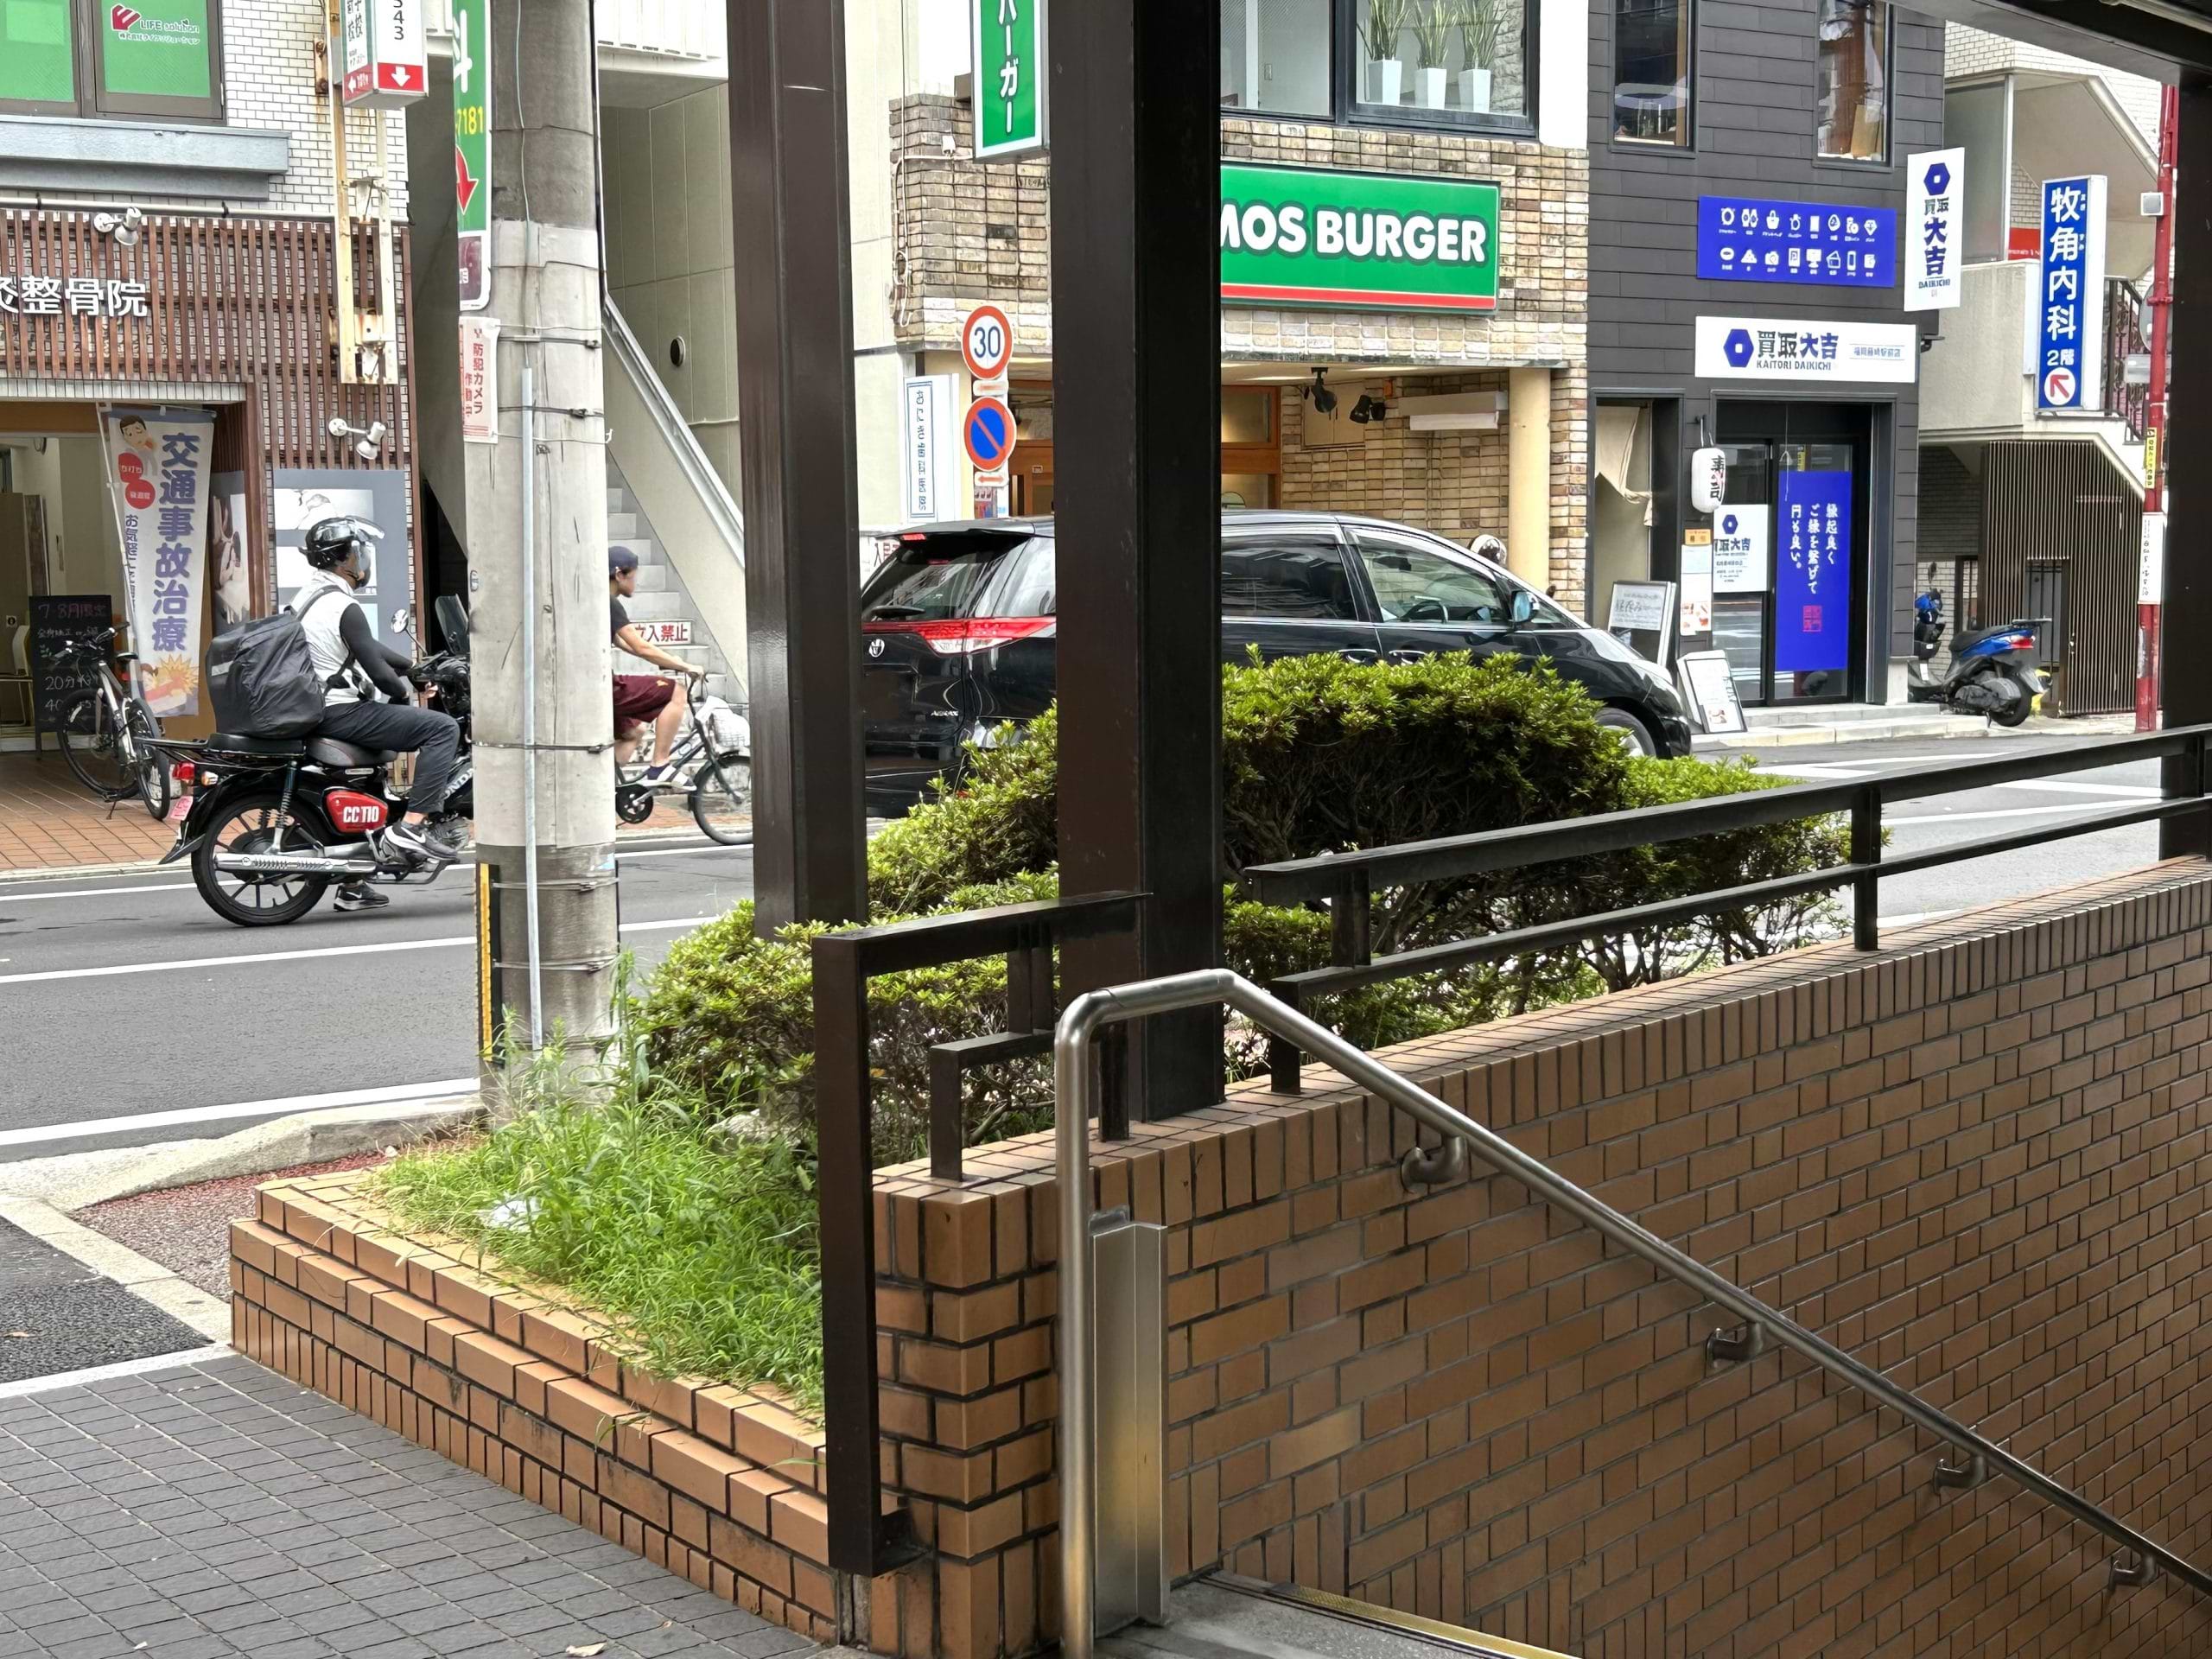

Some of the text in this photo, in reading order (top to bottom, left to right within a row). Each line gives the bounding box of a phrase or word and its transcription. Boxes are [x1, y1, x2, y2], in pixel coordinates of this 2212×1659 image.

[140, 20, 162, 30] LIFE
[1316, 210, 1486, 263] BURGER
[2047, 186, 2081, 341] 牧角内科
[974, 326, 1001, 359] 30
[1757, 330, 1839, 359] 買取大吉
[1757, 359, 1831, 371] KAITORI DAIKICHI
[151, 432, 200, 651] 交通事故治療
[443, 768, 474, 800] ONDA
